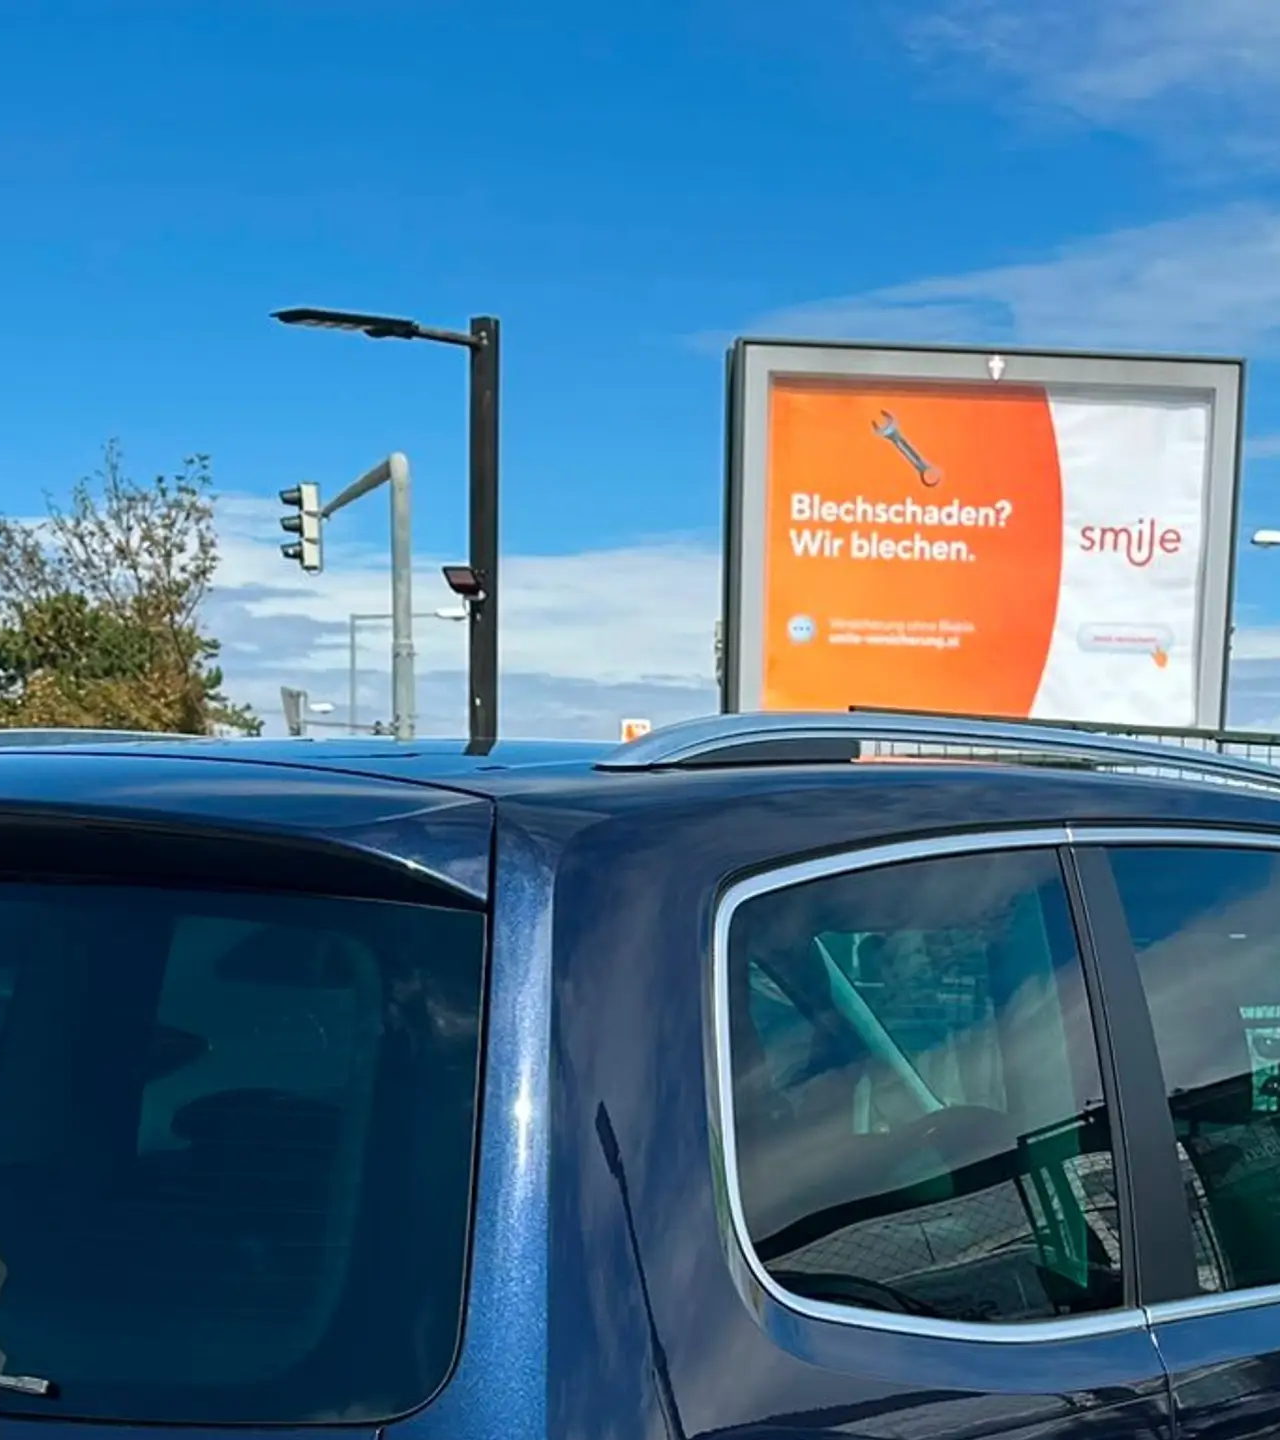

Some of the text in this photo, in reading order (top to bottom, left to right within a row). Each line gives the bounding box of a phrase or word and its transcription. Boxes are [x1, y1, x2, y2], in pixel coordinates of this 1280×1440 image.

[790, 493, 1012, 528] Blechschaden?
[789, 528, 976, 562] Wir blechen.
[1079, 517, 1181, 568] smile
